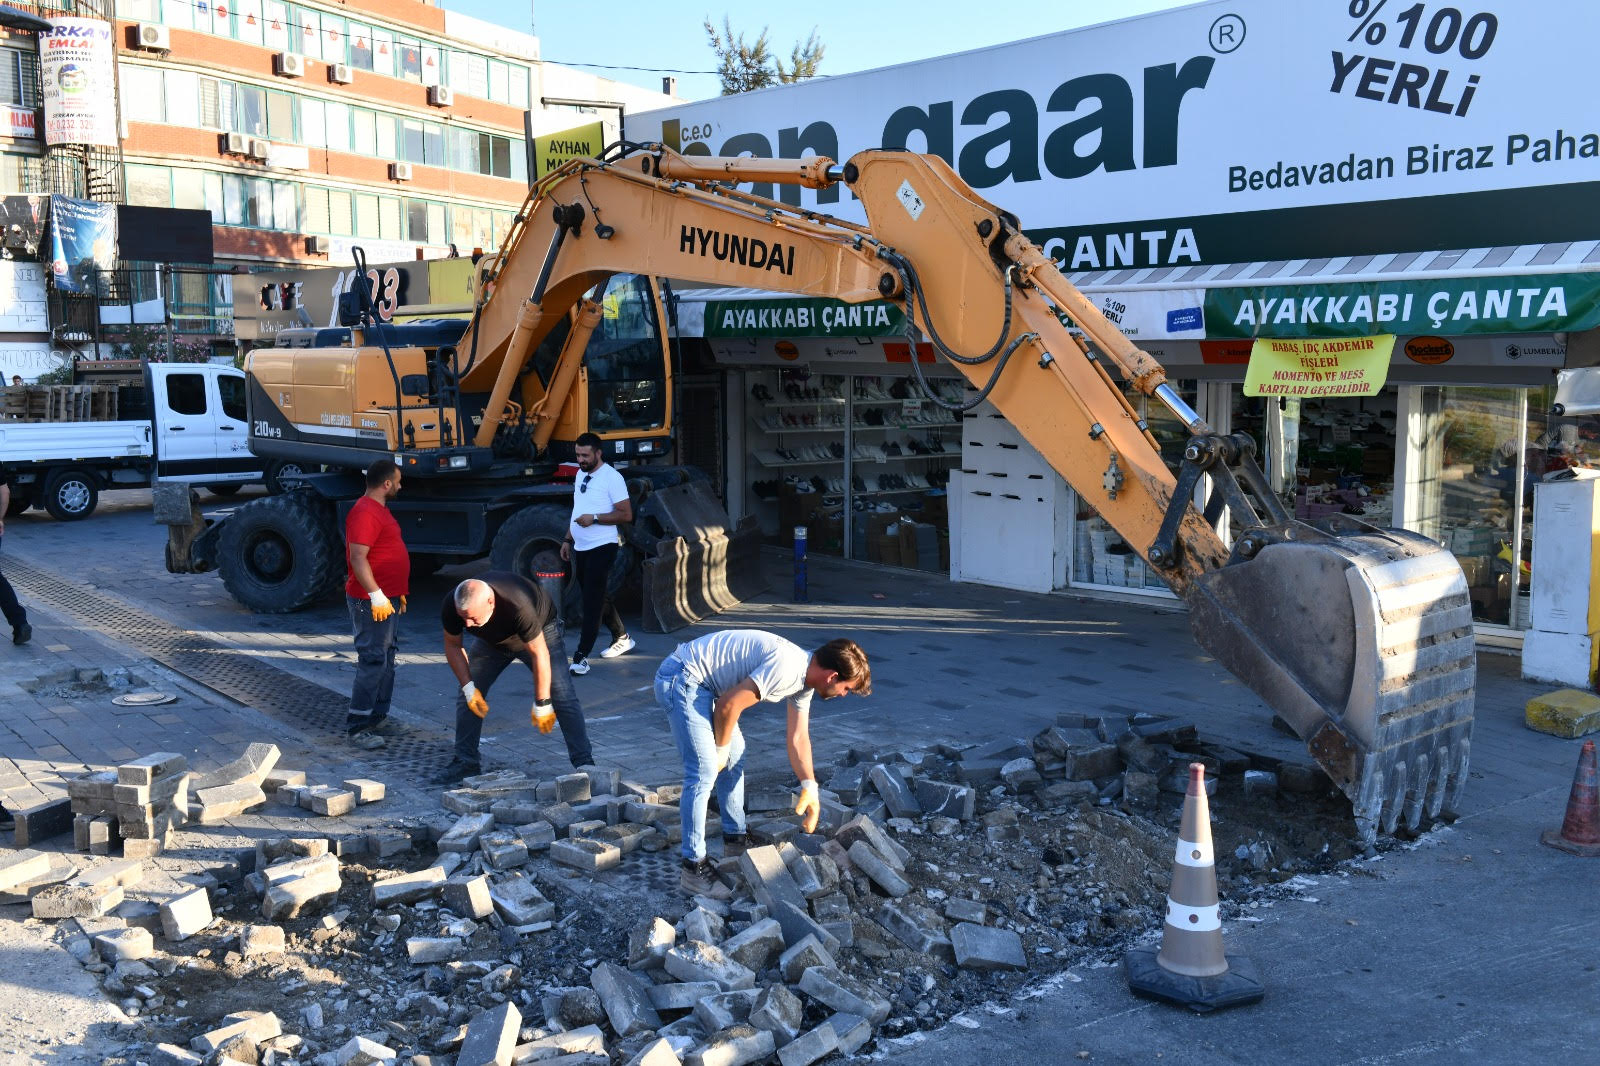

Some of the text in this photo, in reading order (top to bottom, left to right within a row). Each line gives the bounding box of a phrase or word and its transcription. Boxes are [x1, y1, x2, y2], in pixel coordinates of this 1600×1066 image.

[1347, 0, 1498, 60] %100
[49, 39, 95, 48] EMLA
[681, 123, 712, 142] c.e.o
[549, 140, 590, 155] AYHAN
[1228, 129, 1600, 193] Bedavadan Biraz Paha
[680, 225, 795, 275] HYUNDAI
[260, 281, 305, 311] CAFE
[1233, 286, 1568, 328] AYAKKABI ÇANTA
[722, 305, 891, 332] AYAKKABI ÇANTA
[1322, 338, 1374, 353] AKDEMİR
[1300, 354, 1339, 370] FİŞLERİ
[1325, 372, 1337, 381] VE
[1339, 369, 1365, 380] MESS
[1259, 384, 1308, 394] KARTLARI
